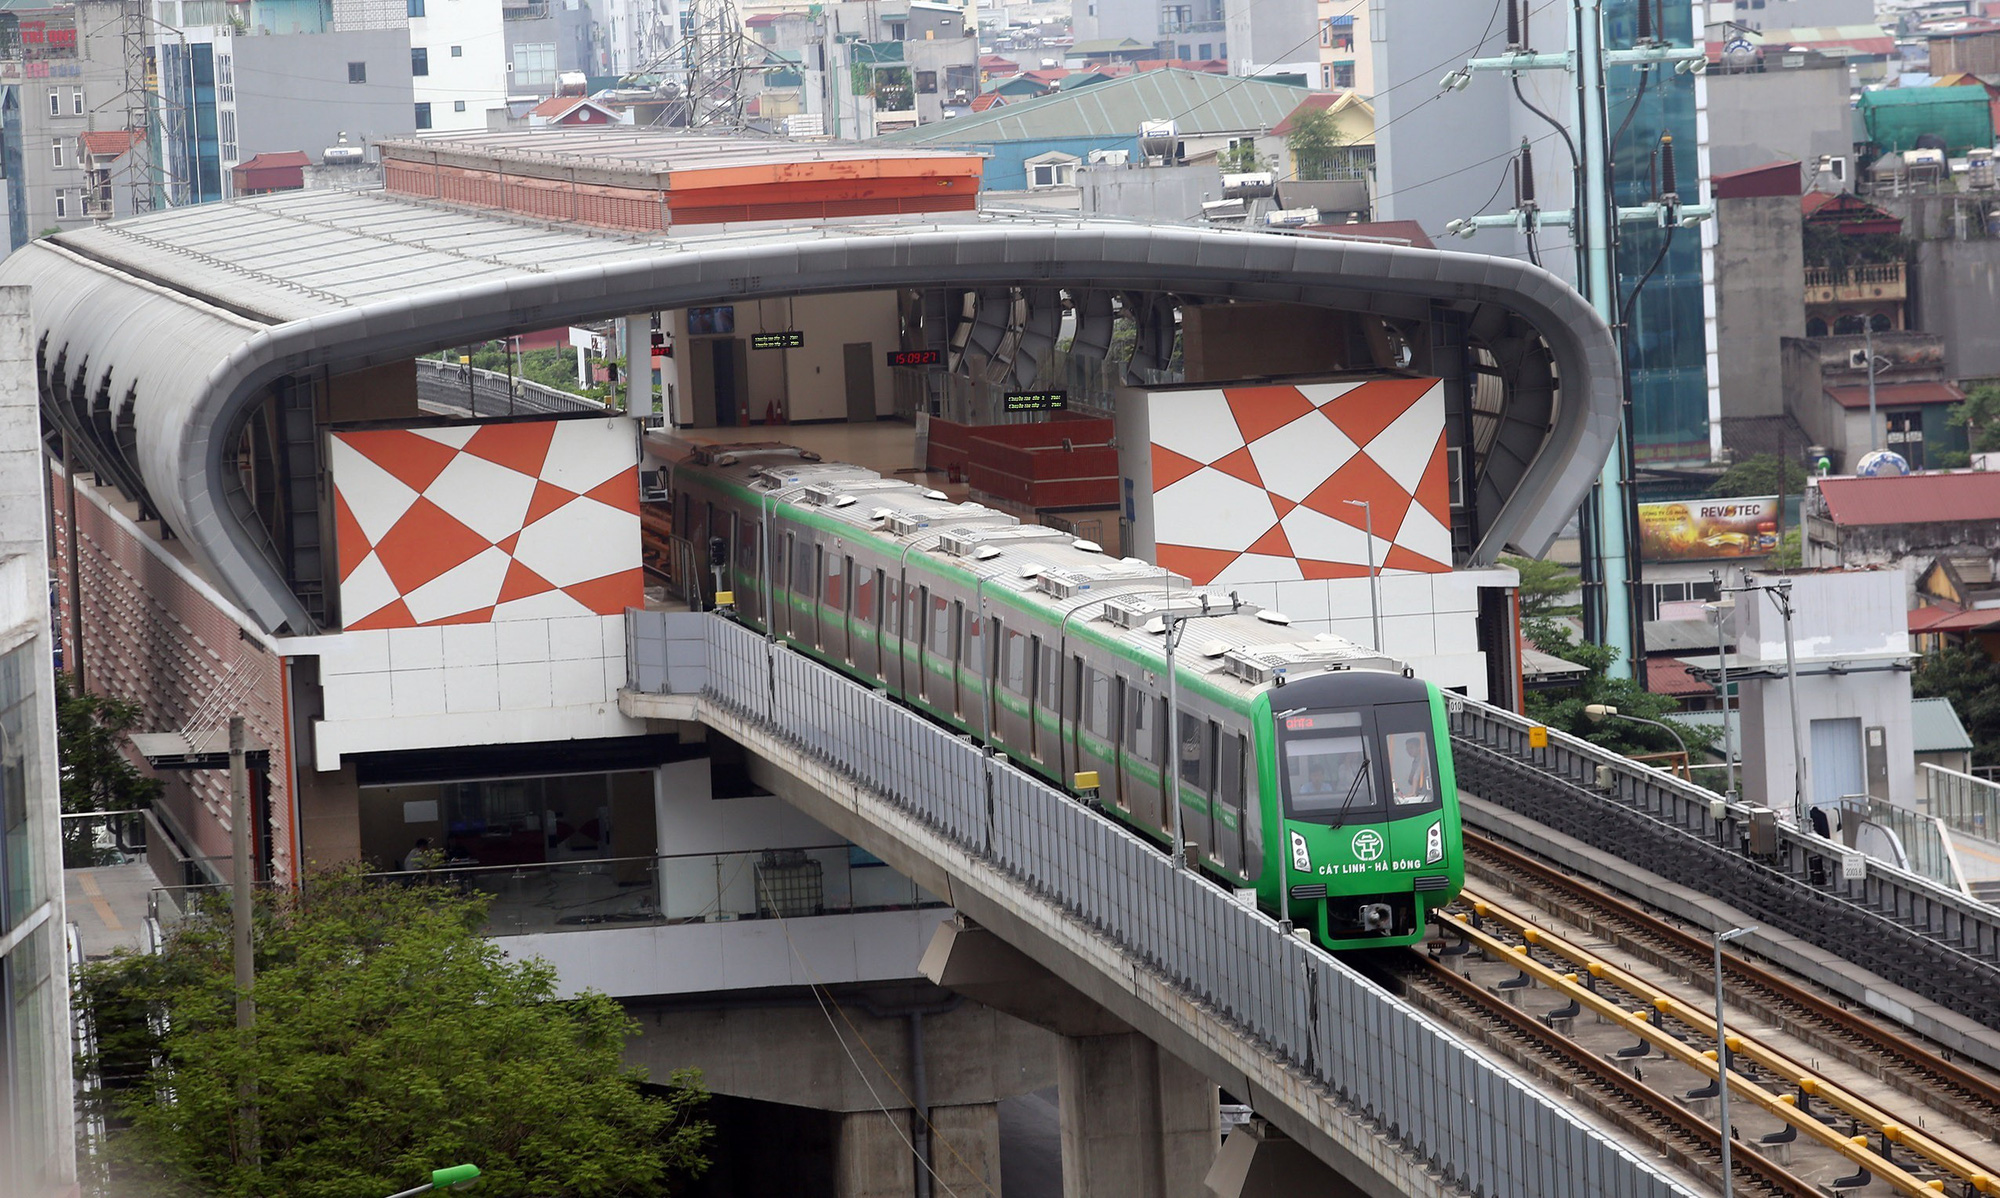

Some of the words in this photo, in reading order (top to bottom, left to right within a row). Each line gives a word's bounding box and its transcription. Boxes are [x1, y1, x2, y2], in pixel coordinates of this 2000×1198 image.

[1319, 864, 1340, 875] CÁT
[1342, 863, 1366, 874] LINH
[1375, 860, 1389, 872] HÀ
[1392, 858, 1421, 871] ĐÔNG
